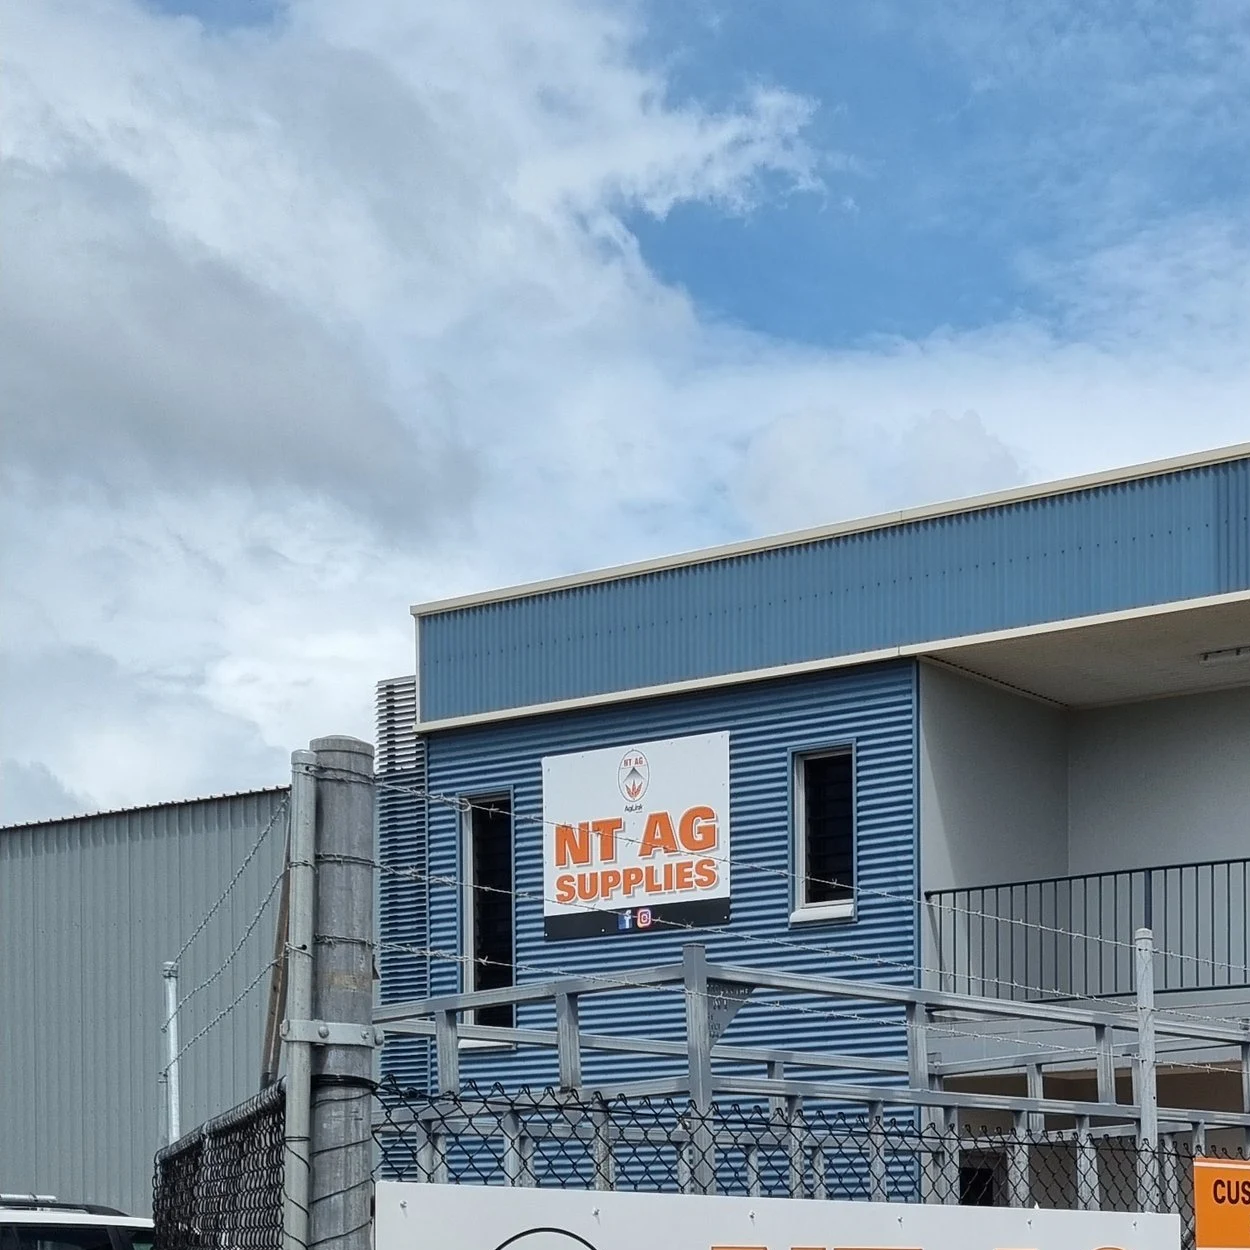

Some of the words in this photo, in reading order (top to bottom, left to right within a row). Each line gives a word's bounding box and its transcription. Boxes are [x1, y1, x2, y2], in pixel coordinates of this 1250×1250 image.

[634, 757, 644, 766] AG
[554, 817, 623, 867] NT
[638, 805, 717, 857] AG
[555, 858, 717, 903] SUPPLIES
